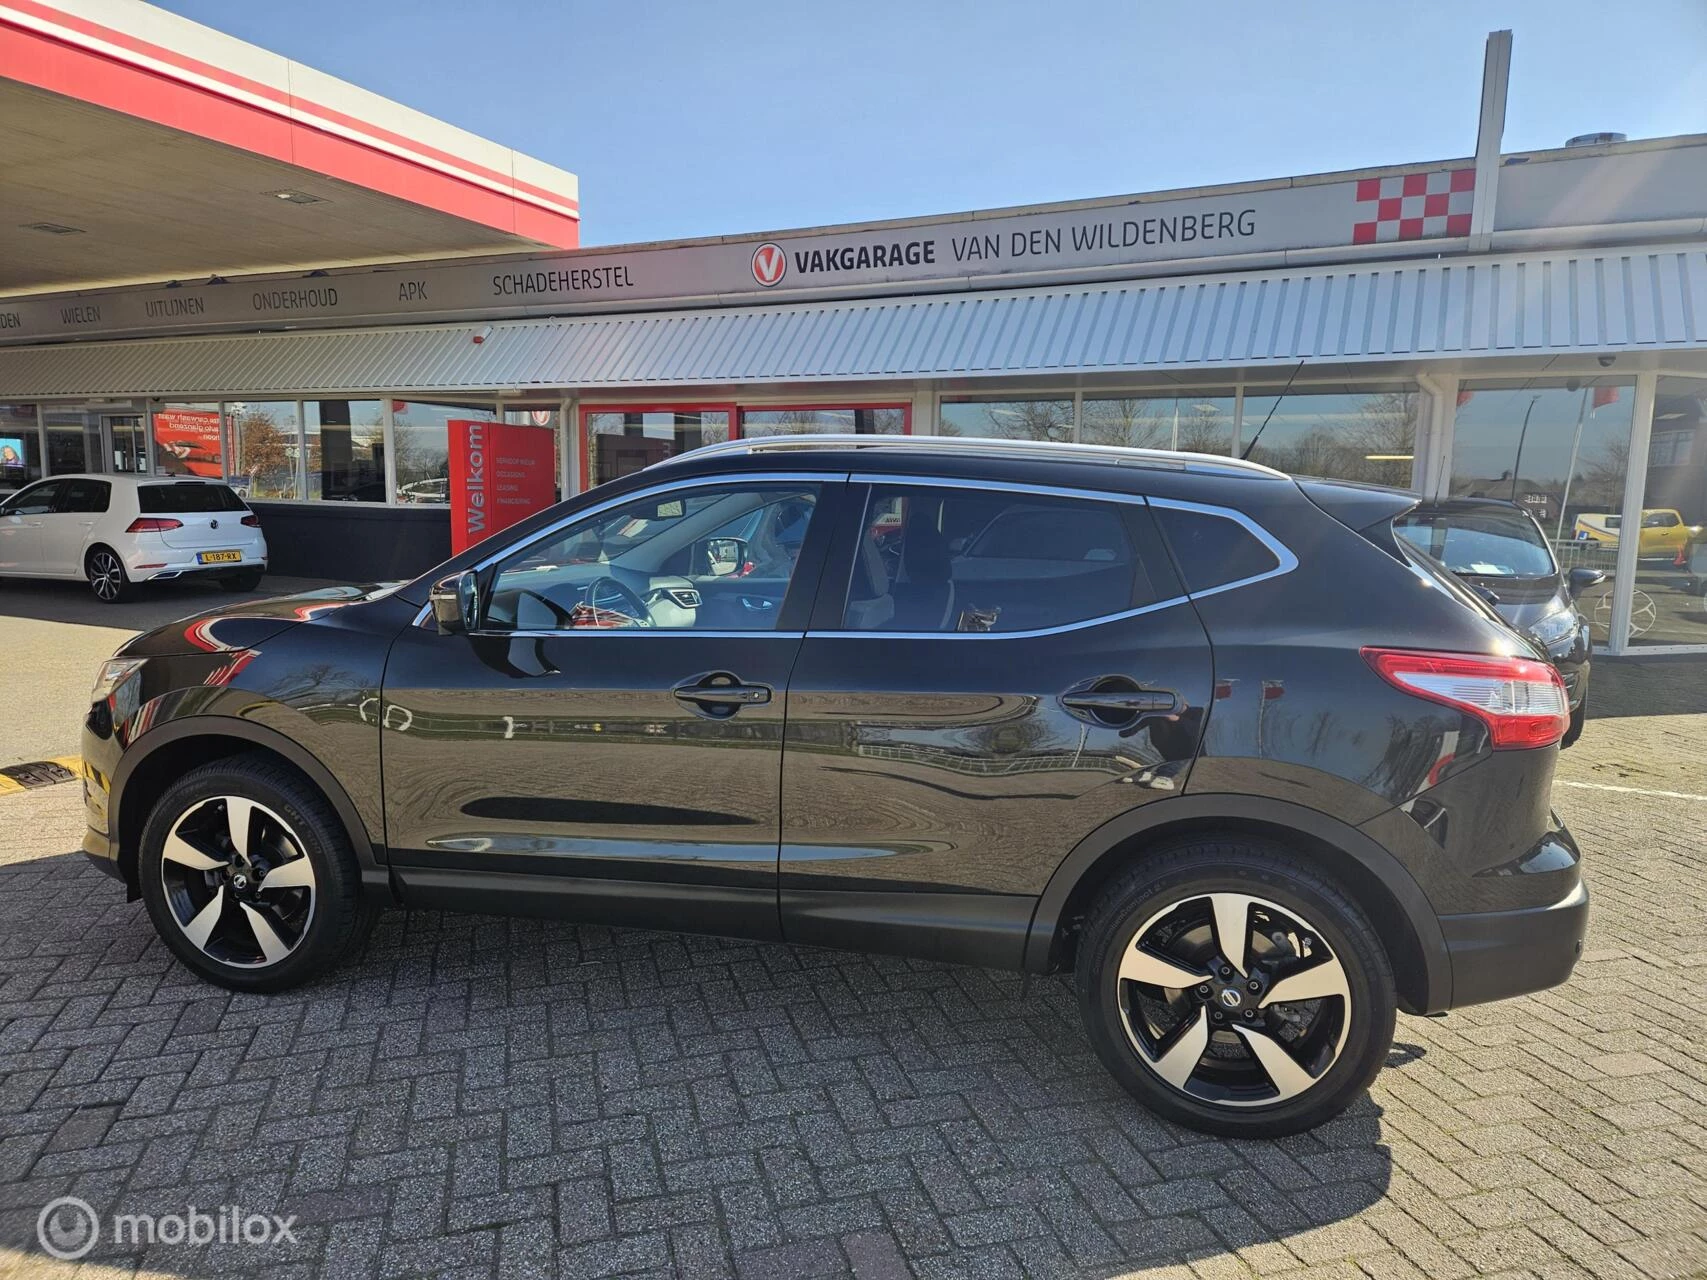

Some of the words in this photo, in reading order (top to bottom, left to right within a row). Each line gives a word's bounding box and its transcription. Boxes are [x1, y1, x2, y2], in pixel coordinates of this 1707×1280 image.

[794, 240, 936, 274] VAKGARAGE
[951, 233, 1000, 262] VAN
[1011, 228, 1062, 257] DEN
[1071, 209, 1256, 252] WILDENBERG
[398, 280, 428, 301] APK
[492, 265, 634, 296] SCHADEHERSTEL
[145, 297, 205, 318] UITLIJNEN
[252, 287, 339, 311] ONDERHOUD
[60, 305, 102, 325] WIELEN
[466, 424, 486, 535] Welkom
[206, 553, 237, 562] L-187-RX
